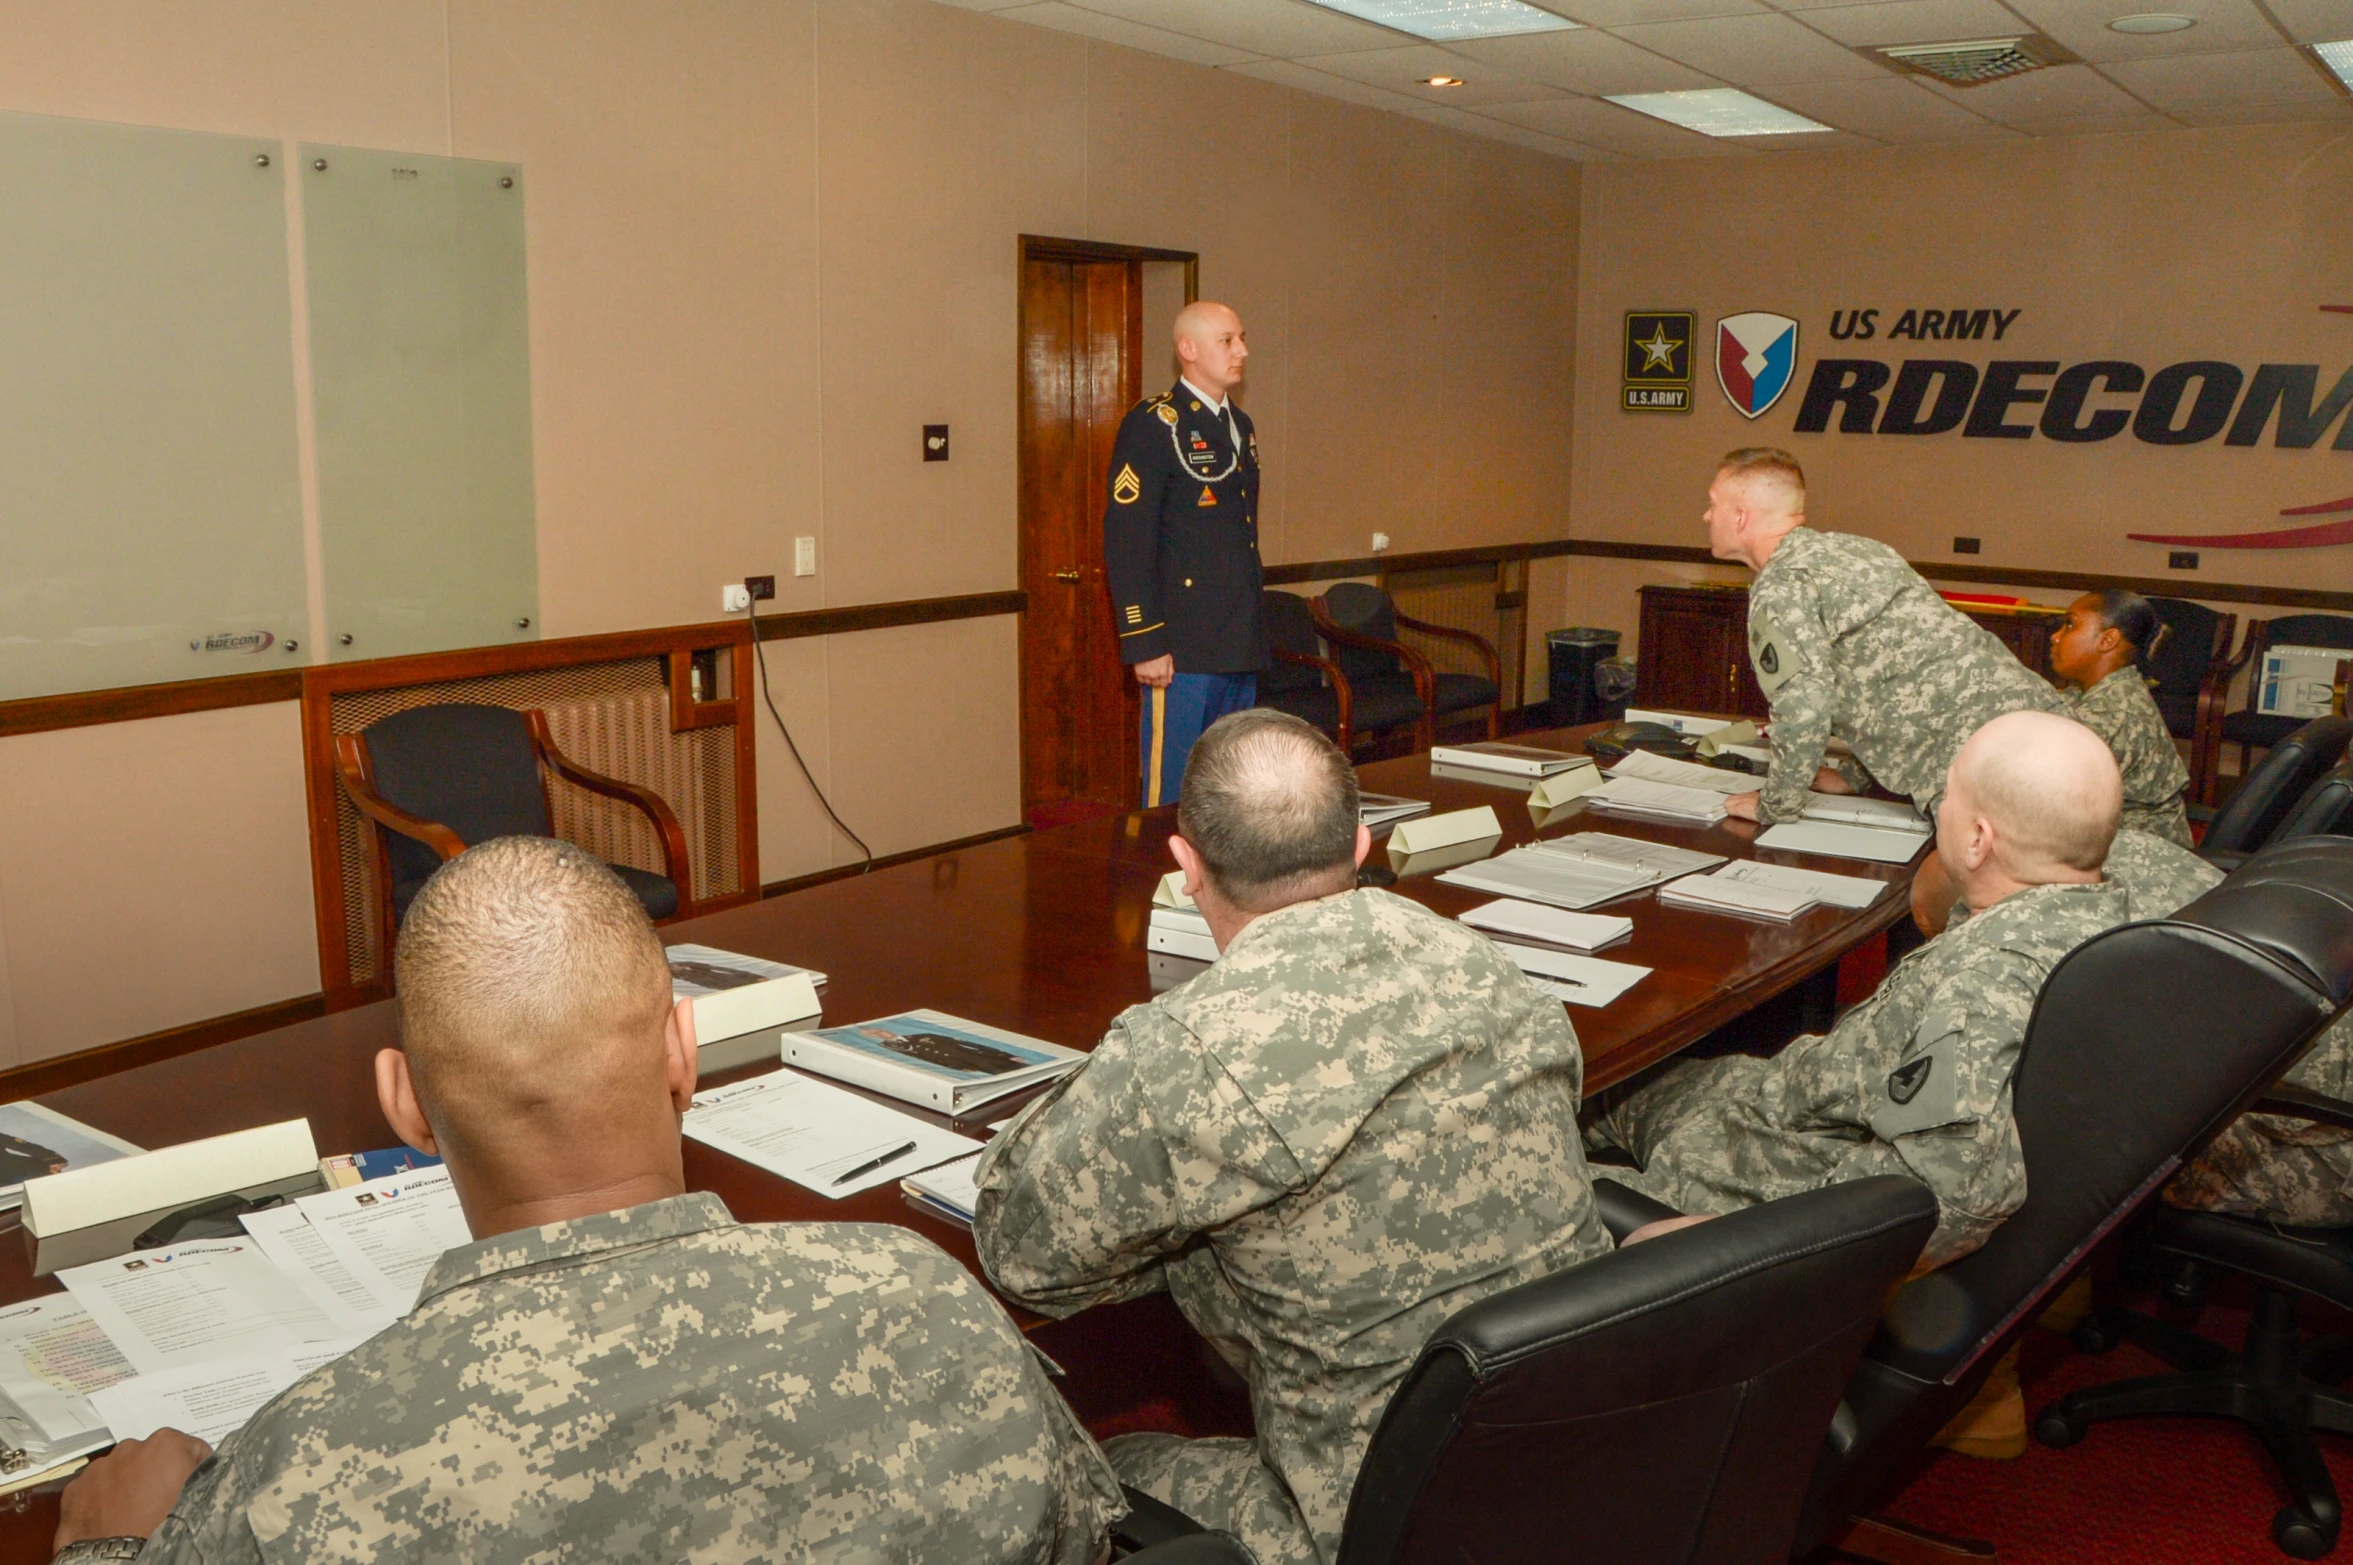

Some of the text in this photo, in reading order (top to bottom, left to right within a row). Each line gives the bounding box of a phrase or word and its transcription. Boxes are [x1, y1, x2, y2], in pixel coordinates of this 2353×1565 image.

[1829, 309, 2022, 340] US ARMY
[1793, 358, 2353, 450] RDECOM
[205, 635, 260, 648] RDECOM
